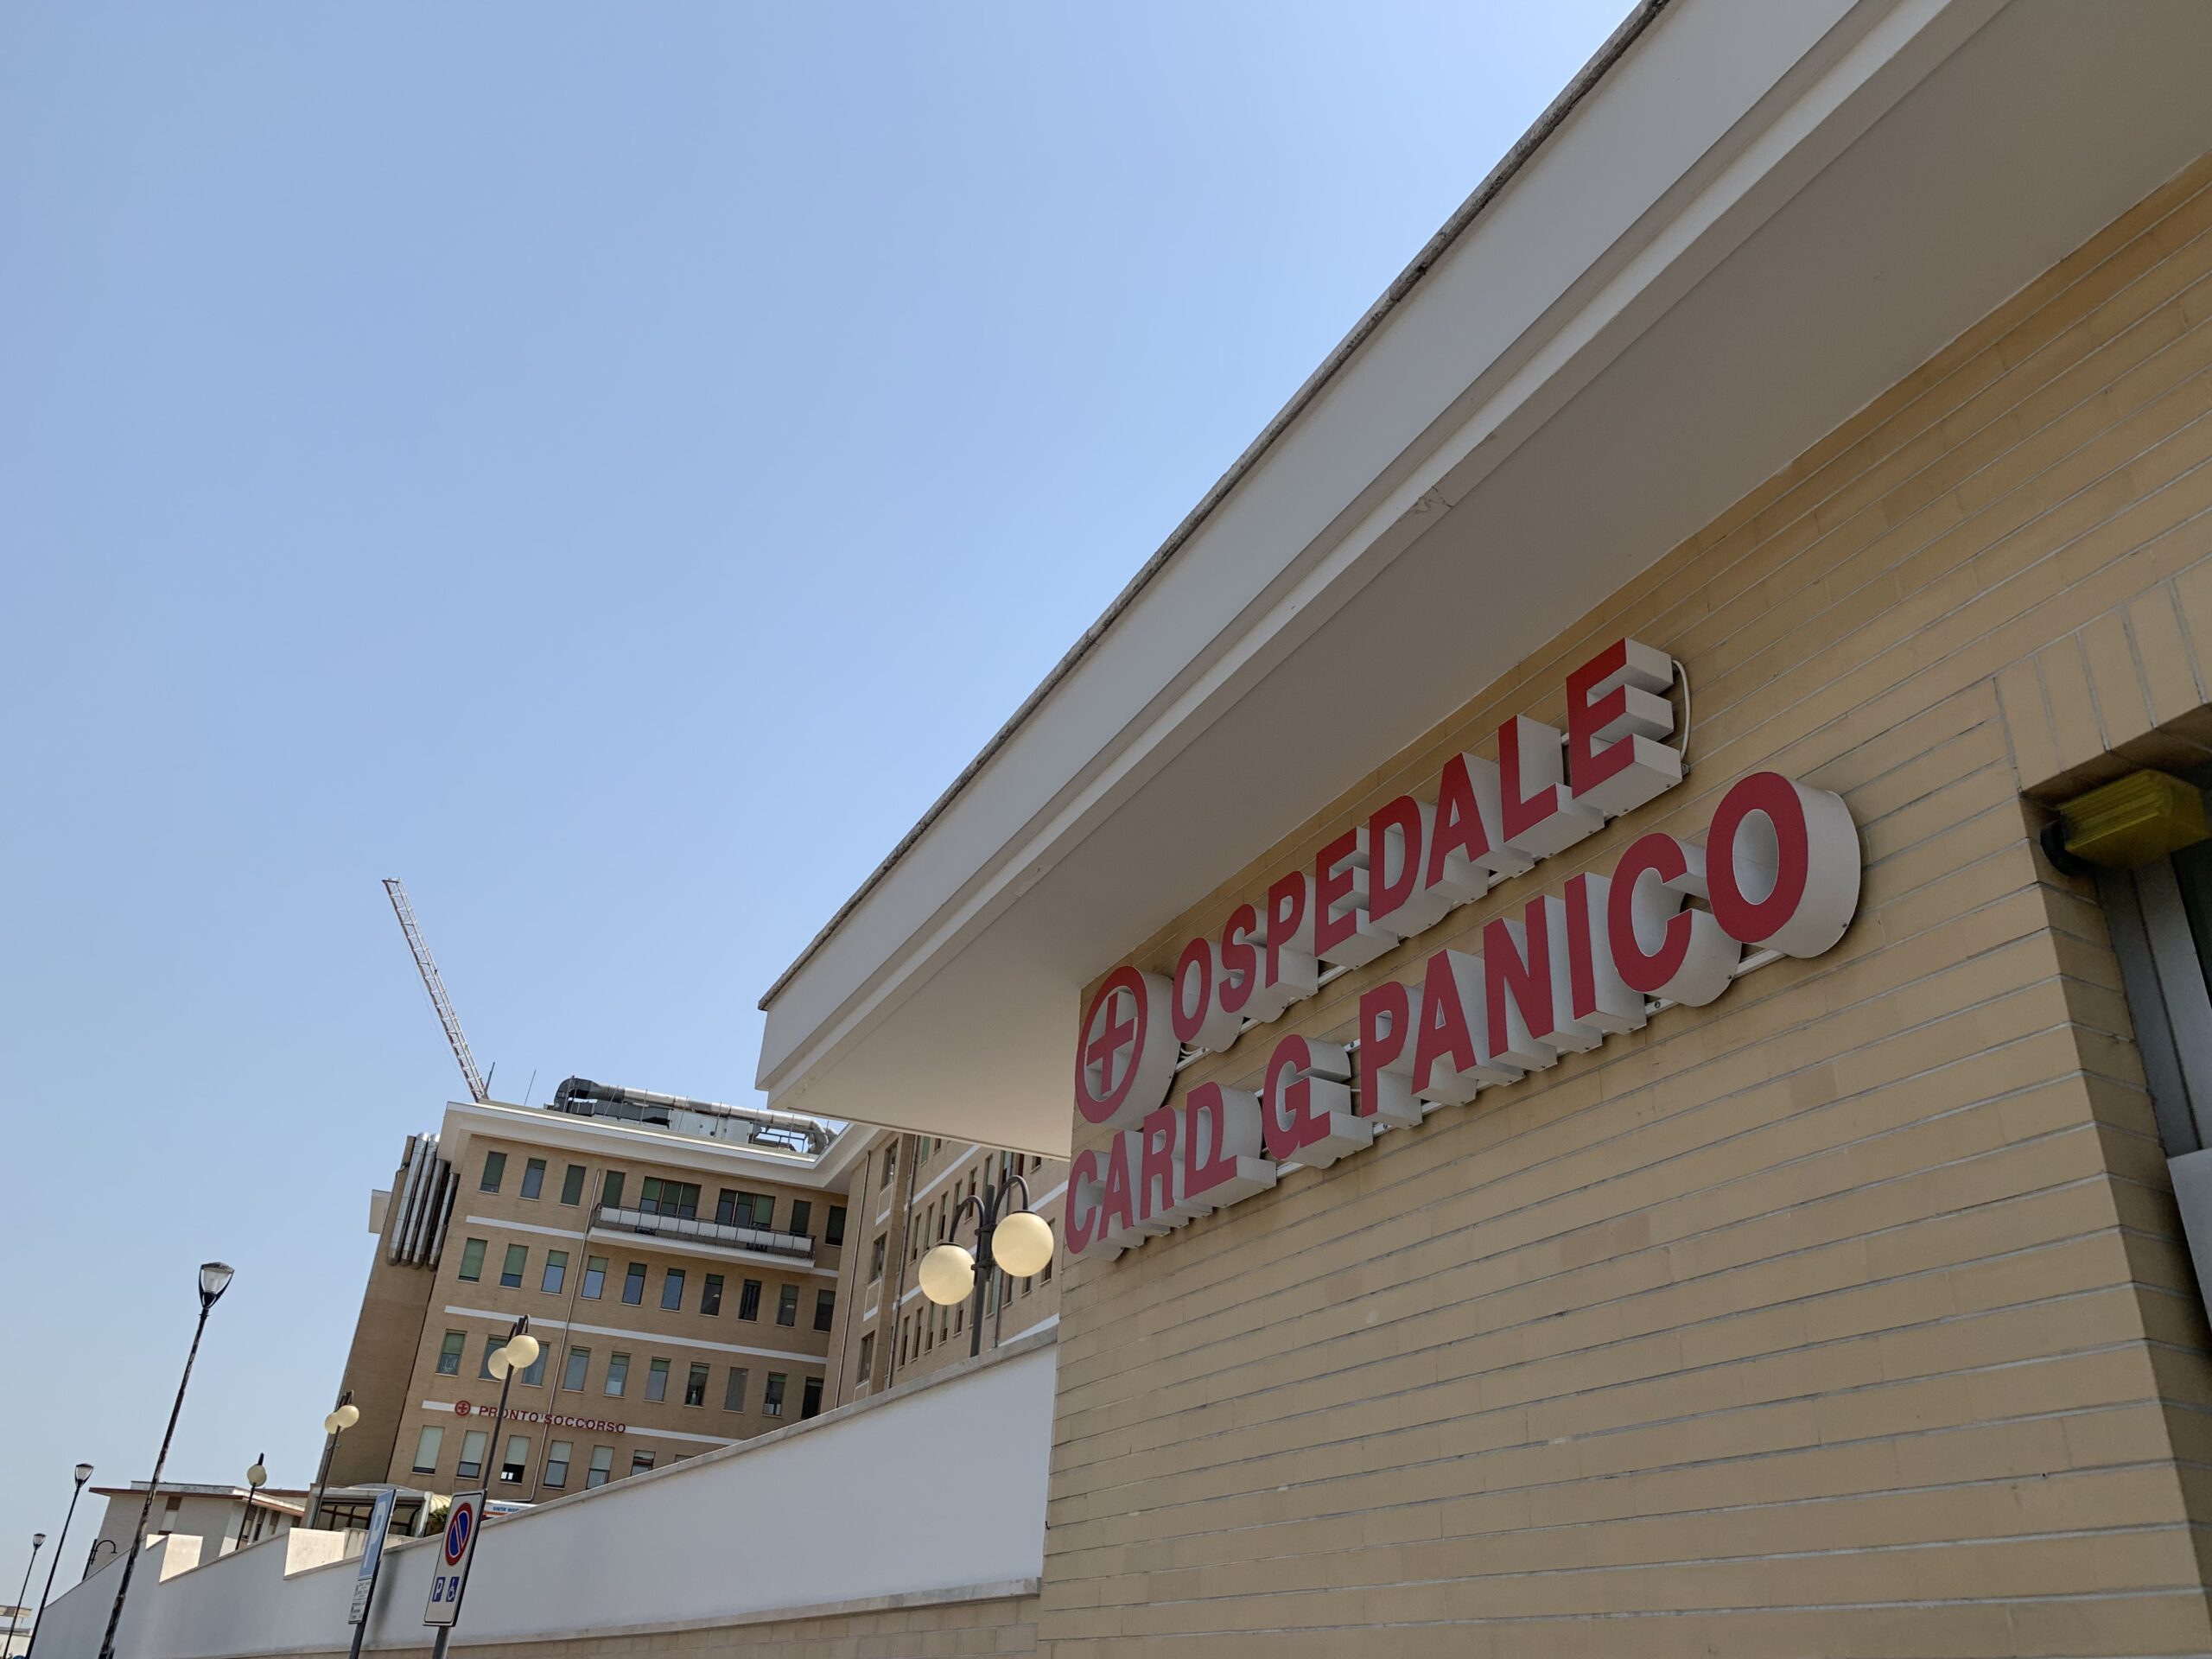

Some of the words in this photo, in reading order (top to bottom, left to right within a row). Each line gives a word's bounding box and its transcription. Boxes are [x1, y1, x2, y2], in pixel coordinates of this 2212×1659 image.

[1173, 638, 1635, 1042] OSPEDALE
[1360, 771, 1808, 1117] PANICO
[543, 1414, 626, 1433] SOCCORSO
[363, 1501, 386, 1568] P
[434, 1579, 444, 1600] P
